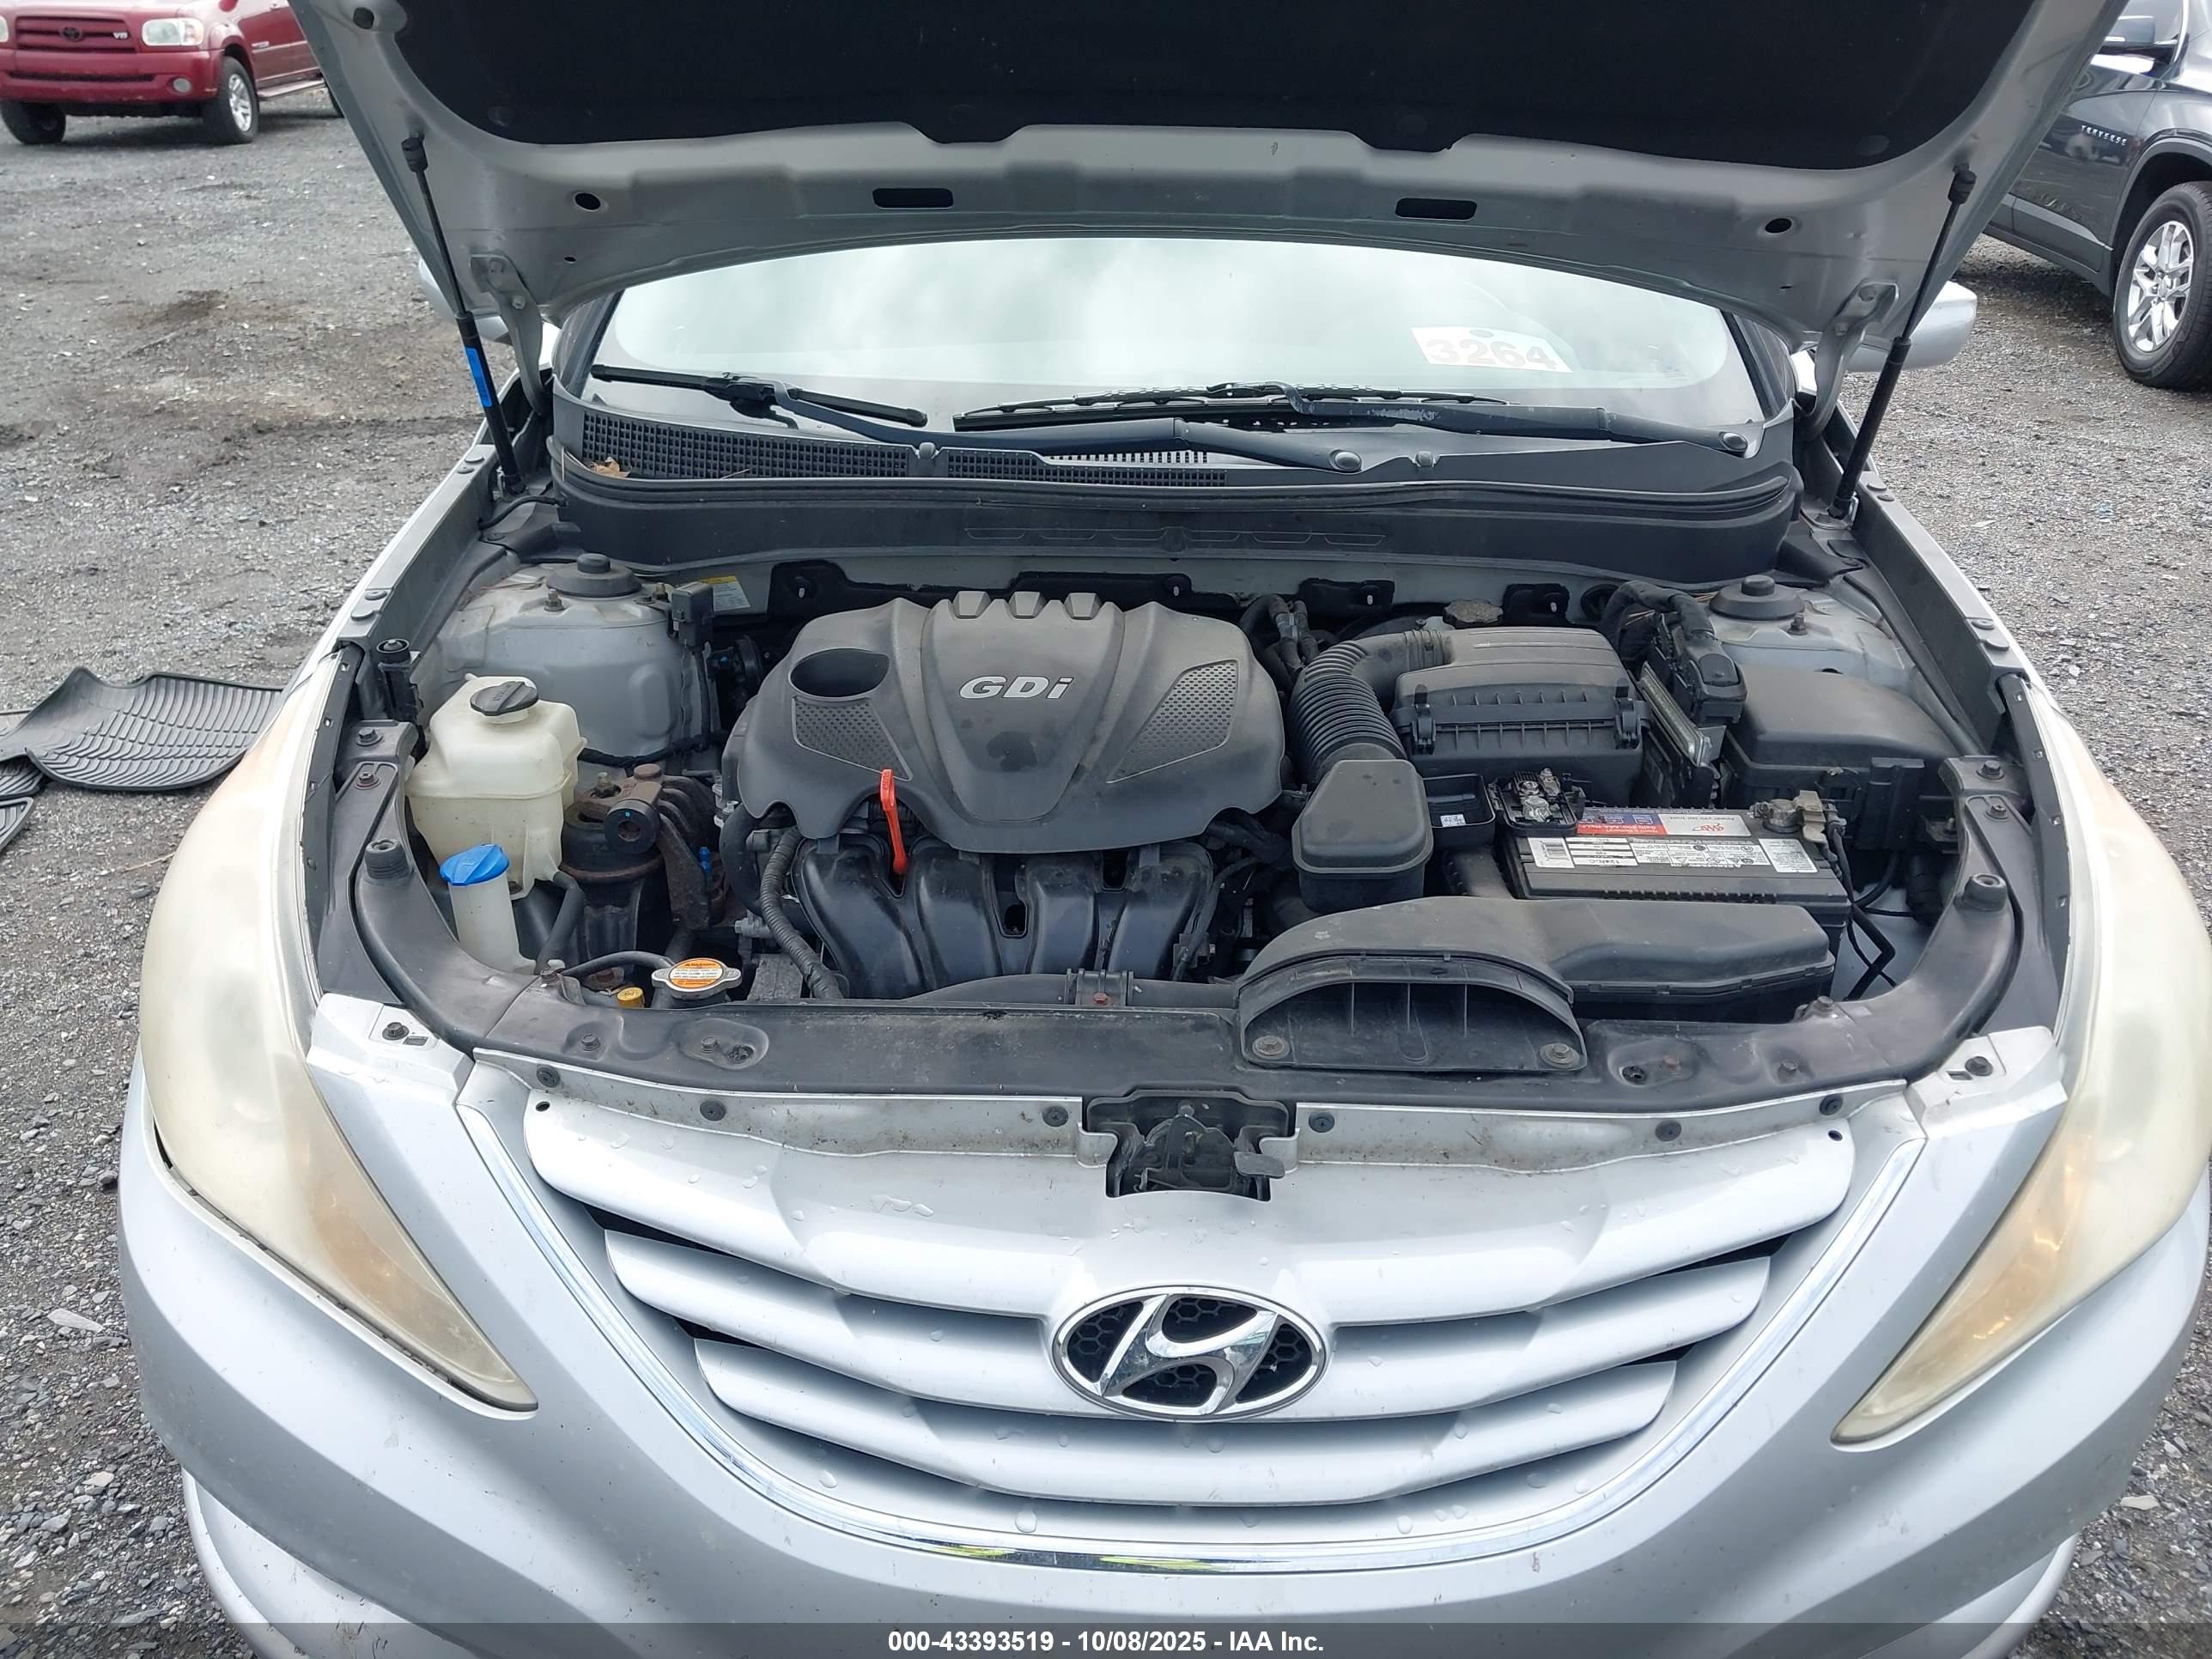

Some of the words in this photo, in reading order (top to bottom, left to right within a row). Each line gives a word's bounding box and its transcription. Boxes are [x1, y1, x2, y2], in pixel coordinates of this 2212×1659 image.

[2081, 125, 2127, 146] TRAVERSE
[1425, 338, 1559, 370] 3264
[958, 675, 1074, 700] GDi
